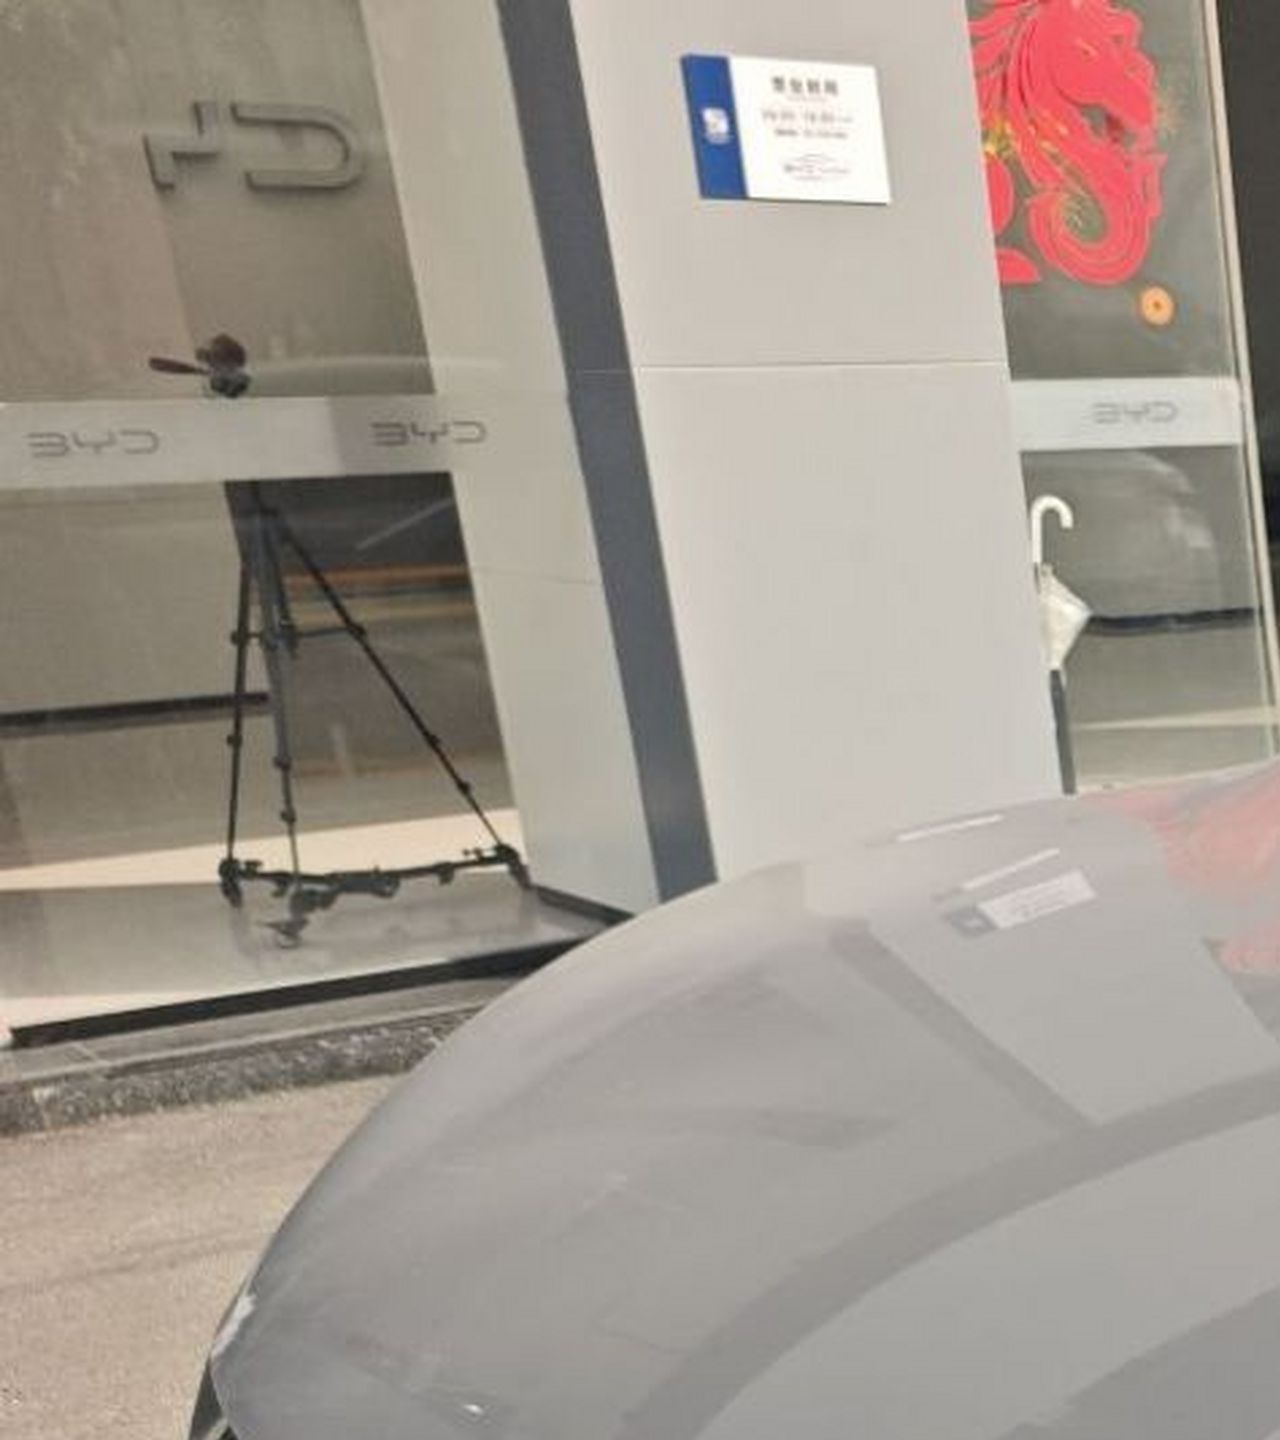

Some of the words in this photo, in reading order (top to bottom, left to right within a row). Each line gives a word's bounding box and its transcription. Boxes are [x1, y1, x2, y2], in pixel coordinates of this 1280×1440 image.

[1092, 400, 1178, 424] BYD
[27, 429, 161, 459] BYD
[370, 420, 488, 446] BYD
